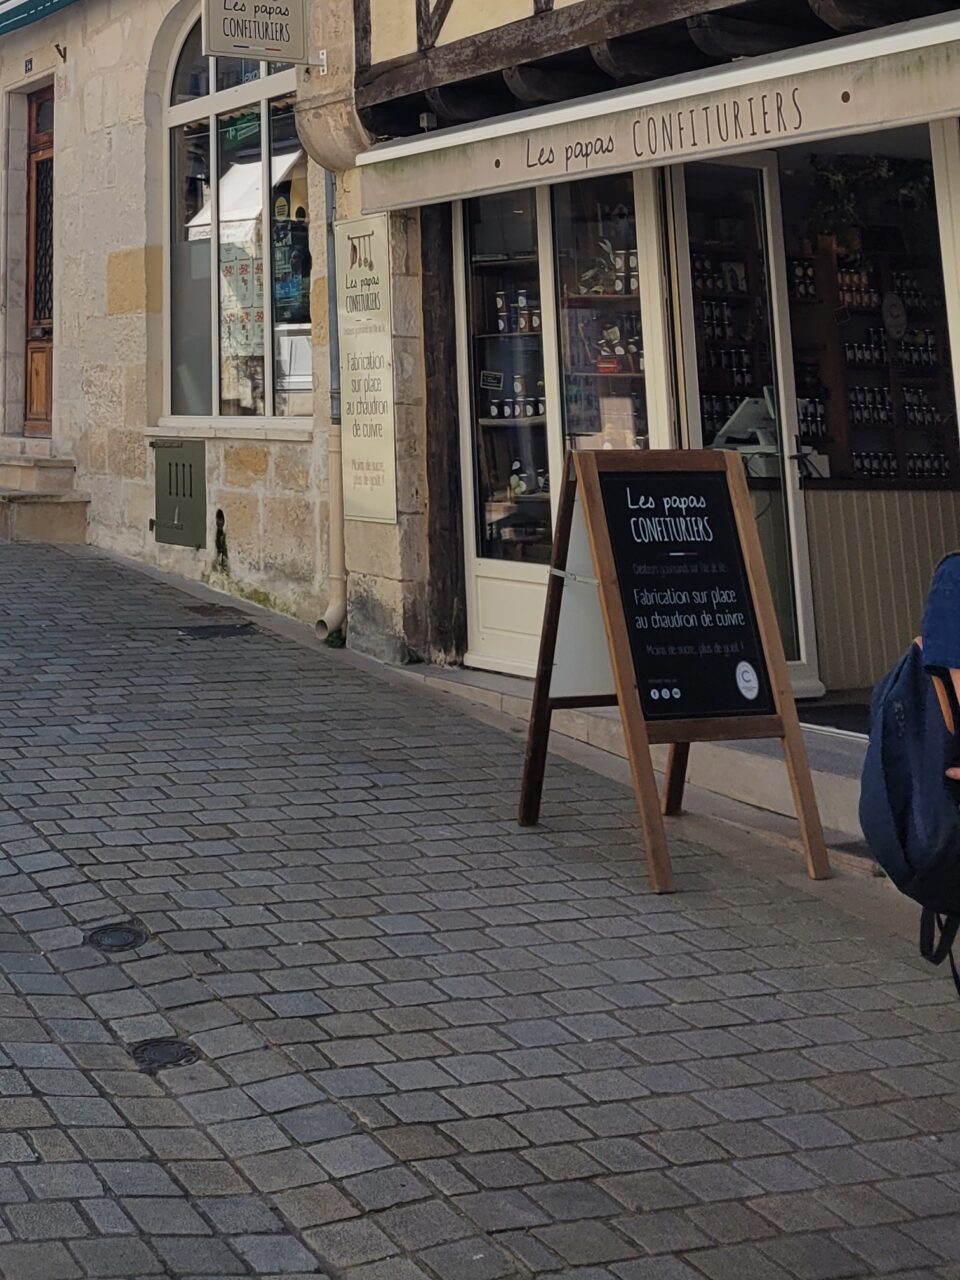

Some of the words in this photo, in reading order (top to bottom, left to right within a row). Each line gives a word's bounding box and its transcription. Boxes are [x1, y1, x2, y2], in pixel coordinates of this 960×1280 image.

[254, 5, 290, 20] papas
[223, 17, 291, 42] CONFITURIERS
[526, 138, 555, 168] Les
[565, 135, 614, 172] papas
[632, 87, 803, 157] CONFITURIERS
[346, 273, 357, 289] Les
[361, 275, 380, 292] papas
[345, 291, 381, 313] CONFITURIERS
[347, 352, 385, 371] Fabrication
[351, 378, 361, 393] sur
[363, 373, 382, 400] place
[346, 402, 355, 415] au
[356, 396, 389, 415] chaudron
[352, 419, 361, 438] de
[362, 418, 383, 438] cuivre
[626, 487, 655, 509] Les
[662, 495, 706, 515] papas
[630, 517, 714, 542] CONFITURIERS
[633, 587, 690, 606] Fabrication
[691, 591, 708, 604] sur
[711, 586, 737, 610] place
[635, 616, 648, 629] au
[650, 610, 698, 628] chaudron
[700, 610, 714, 627] de
[715, 609, 746, 626] cuivre
